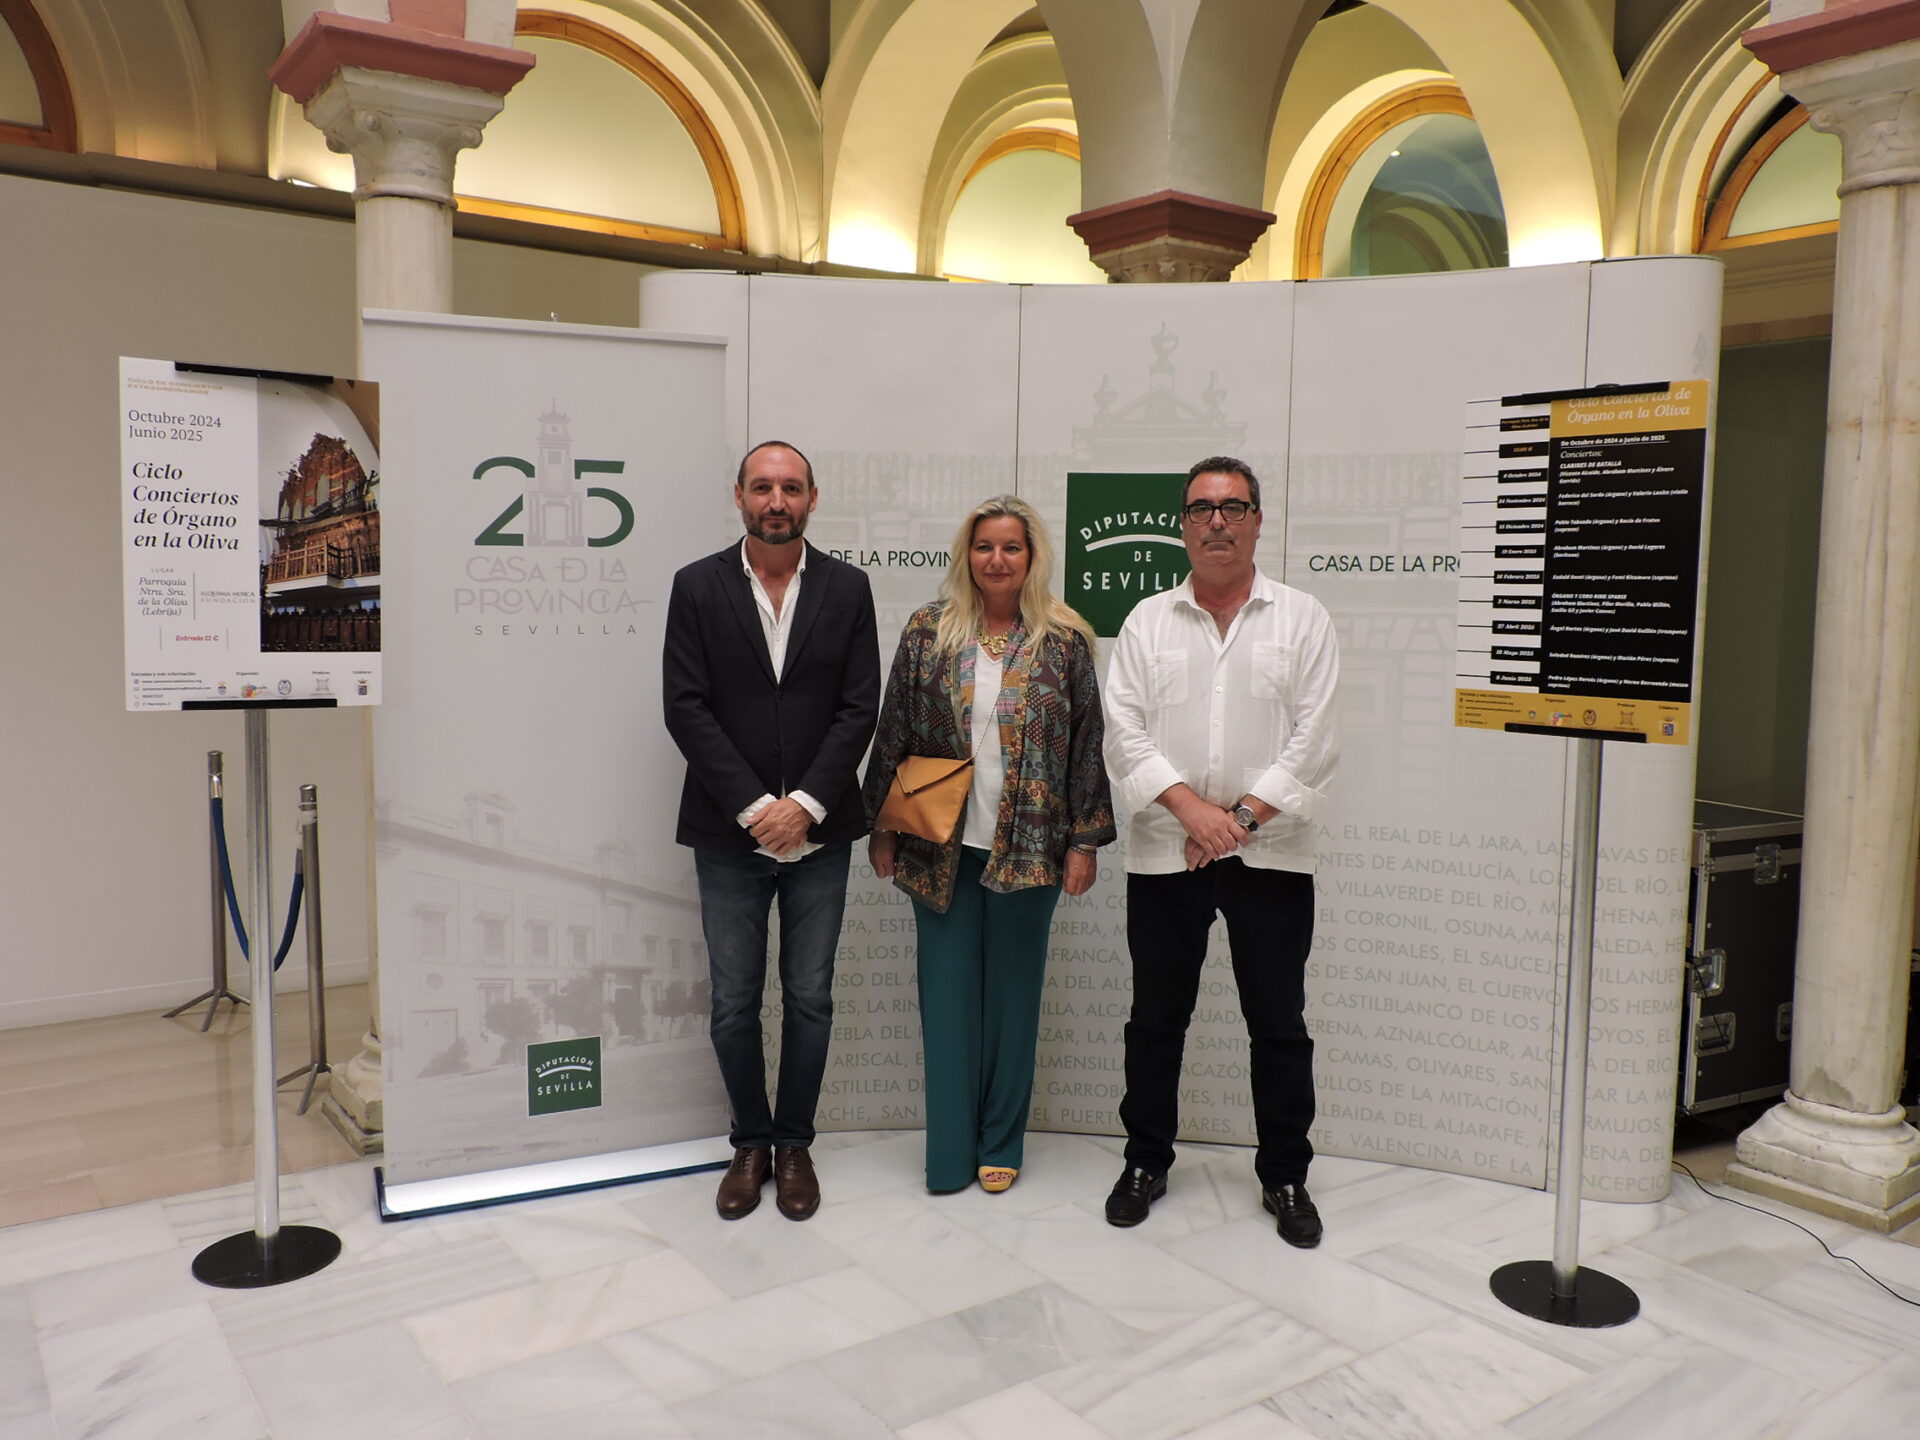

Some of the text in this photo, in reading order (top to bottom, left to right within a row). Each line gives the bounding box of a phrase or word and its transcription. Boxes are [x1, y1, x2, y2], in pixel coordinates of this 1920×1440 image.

[1675, 388, 1692, 400] de
[128, 409, 222, 428] Octubre 2024
[1567, 405, 1690, 425] Órgano en la Oliva
[128, 425, 203, 441] Junio 2025
[132, 461, 183, 480] Ciclo
[132, 485, 239, 506] Conciertos
[472, 456, 635, 548] 25
[133, 506, 237, 531] de Órgano
[1080, 512, 1183, 540] DIPUTACI
[134, 532, 239, 550] en la Oliva
[860, 550, 881, 566] LA
[887, 550, 952, 567] PROVIN
[1134, 550, 1152, 562] DE
[1309, 555, 1460, 573] CASA DE LA PR
[465, 556, 547, 584] CASA
[599, 557, 629, 584] LA
[139, 577, 187, 586] Parroquia
[167, 588, 186, 596] Sra.
[137, 597, 188, 606] de la Oliva
[142, 607, 182, 616] (Lebrija)
[175, 634, 204, 642] Entrada
[474, 625, 637, 636] SEVILLA
[1343, 824, 1362, 840] EL
[1368, 825, 1411, 844] REAL
[1418, 829, 1443, 846] DE
[1449, 831, 1471, 849] LA
[1477, 834, 1529, 857] JARA,
[1536, 838, 1572, 859] LAS
[1598, 847, 1649, 864] AVAS
[1319, 850, 1365, 868] NTES
[1371, 854, 1396, 871] DE
[1401, 856, 1521, 885] ANDALUCÍA,
[1529, 868, 1571, 889] LOR
[1336, 880, 1532, 916] VILLAVERDE DEL RÍO,
[1320, 908, 1339, 924] EL
[1344, 909, 1438, 935] CORONIL,
[867, 945, 898, 960] LOS
[1051, 948, 1125, 967] FRANCA,
[1311, 935, 1337, 951] OS
[1344, 937, 1446, 965] CORRALES,
[1453, 948, 1473, 964] EL
[871, 972, 903, 987] DEL
[1065, 975, 1096, 990] DEL
[1326, 964, 1350, 980] DE
[1354, 965, 1391, 984] SAN
[1397, 970, 1451, 994] JUAN,
[1457, 977, 1477, 994] EL
[1591, 996, 1619, 1014] OS
[867, 1000, 887, 1014] LA
[1322, 991, 1463, 1020] CASTILBLANCO
[1471, 1007, 1495, 1025] DE
[1503, 1012, 1540, 1032] LOS
[834, 1025, 912, 1041] EBLA DEL
[1087, 1029, 1107, 1044] LA
[1195, 1035, 1248, 1053] SANTI
[1307, 1018, 1368, 1040] ERENA,
[1374, 1026, 1515, 1061] AZNALCÓLLAR,
[1604, 1057, 1640, 1075] DEL
[1327, 1048, 1648, 1104] CAMAS, OLIVARES, LA
[537, 1080, 593, 1096] SEVILLA
[820, 1079, 901, 1095] ASTILLEJA
[1047, 1081, 1127, 1099] GARROB
[1315, 1073, 1542, 1123] ULLOS DE LA MITACIÓN,
[881, 1105, 917, 1120] SAN
[1393, 1111, 1427, 1129] DEL
[1434, 1117, 1530, 1149] ALJARAFE,
[1350, 1133, 1533, 1176] VALENCINA DE LA
